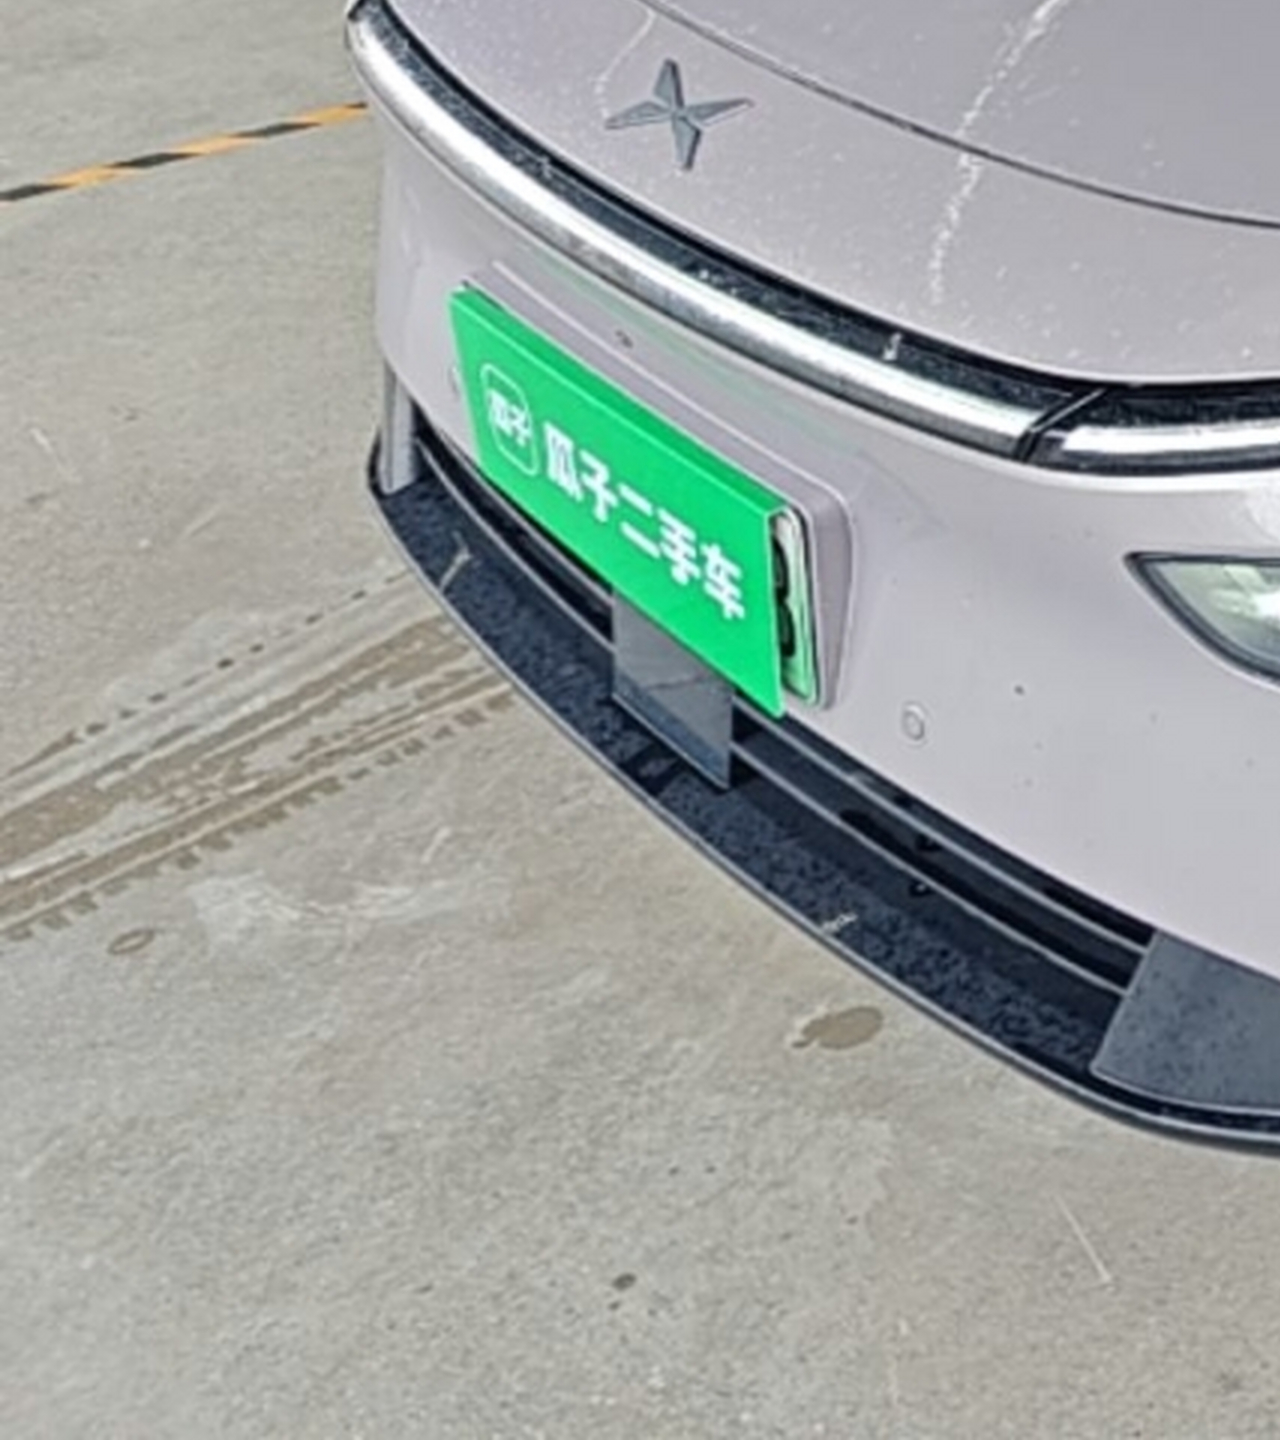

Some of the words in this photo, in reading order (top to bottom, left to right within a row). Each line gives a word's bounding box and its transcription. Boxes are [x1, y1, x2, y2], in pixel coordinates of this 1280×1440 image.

[543, 421, 746, 621] 瓜子二手车
